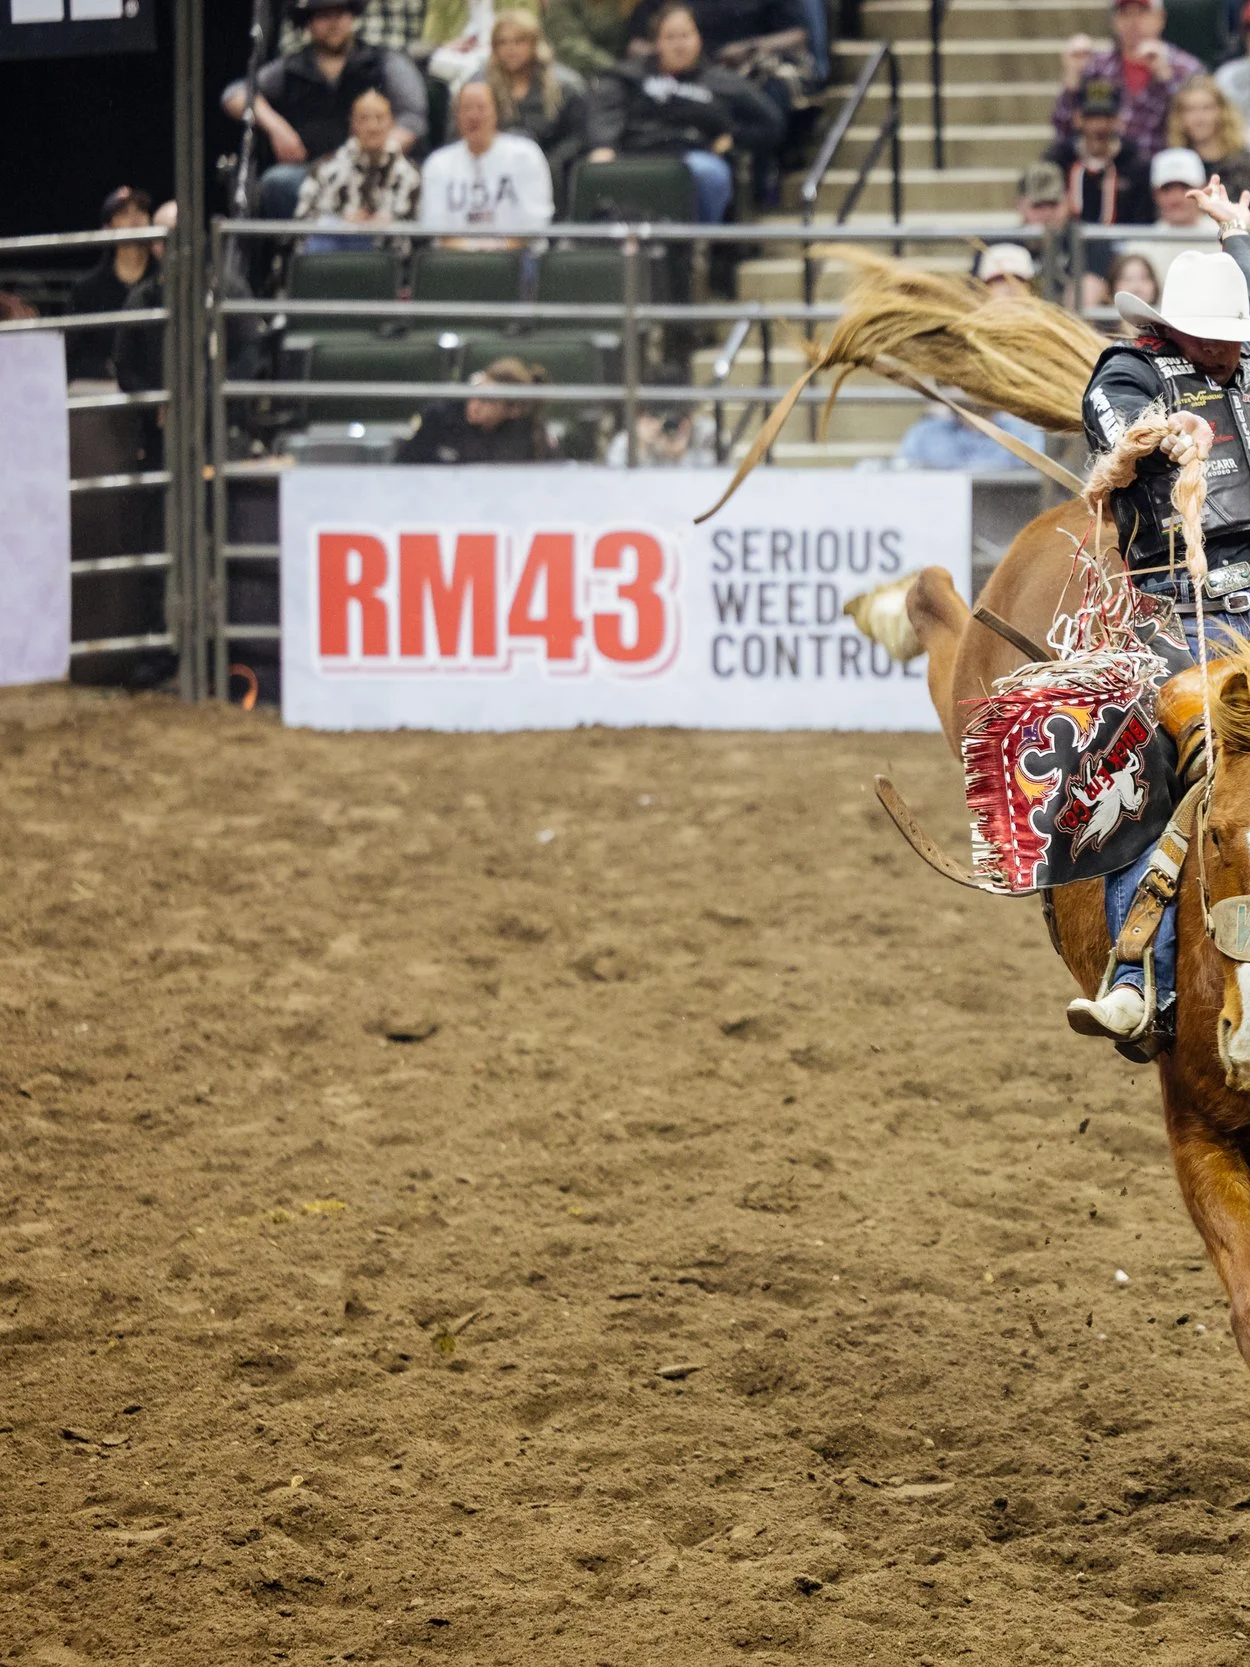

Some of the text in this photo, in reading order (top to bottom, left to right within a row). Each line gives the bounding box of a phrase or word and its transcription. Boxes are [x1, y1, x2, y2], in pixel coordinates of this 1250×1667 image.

[711, 528, 903, 574] SERIOUS
[317, 531, 669, 664] RM43
[712, 581, 839, 626] WEED
